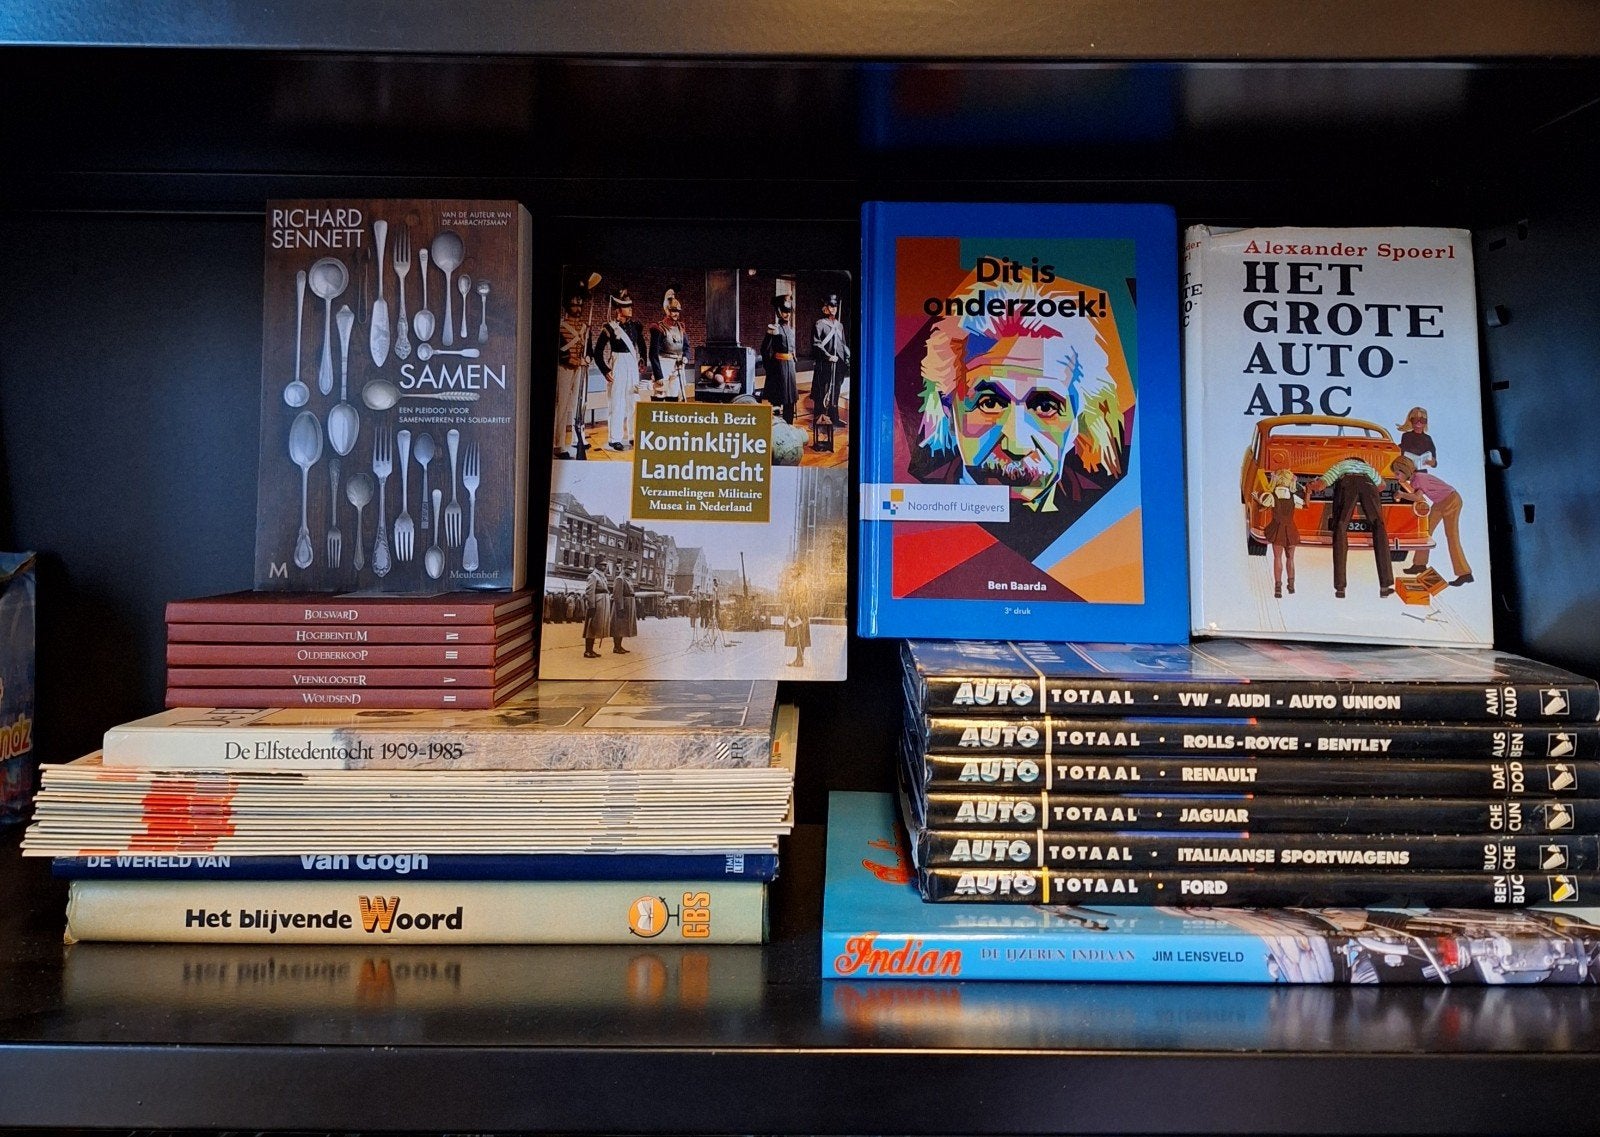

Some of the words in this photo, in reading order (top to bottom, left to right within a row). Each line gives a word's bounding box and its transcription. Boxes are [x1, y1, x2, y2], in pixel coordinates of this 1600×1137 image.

[273, 209, 362, 228] RICHARD
[442, 211, 456, 219] VAN
[458, 211, 467, 219] DE
[469, 211, 496, 219] AUTEUR
[497, 211, 512, 219] VAN
[272, 229, 364, 249] SENNETT
[1243, 240, 1367, 257] Alexander
[1377, 243, 1455, 261] Spoerl
[976, 256, 1022, 284] Dit
[1032, 256, 1055, 284] is
[1243, 261, 1363, 296] HET
[923, 290, 1107, 318] onderzoek!
[1243, 300, 1444, 338] GROTE
[1243, 342, 1408, 378] AUTO-
[399, 363, 506, 389] SAMEN
[399, 406, 413, 414] EEN
[415, 406, 447, 414] PLEIDOOI
[448, 406, 470, 414] VOOR
[1244, 383, 1352, 417] ABC
[399, 416, 453, 424] SAMENWERKEN
[456, 416, 466, 424] EN
[468, 416, 512, 424] SOLIDARITEIT
[651, 411, 719, 424] Historisch
[724, 412, 757, 425] Bezit
[639, 430, 767, 459] Koninklijke
[641, 459, 764, 482] Landmacht
[639, 486, 715, 500] Verzamelingen
[718, 488, 762, 499] Militaire
[649, 500, 682, 511] Musea
[685, 501, 696, 511] in
[700, 501, 753, 512] Nederland
[908, 501, 957, 512] Noordhoff
[960, 502, 1005, 514] Uitgevers
[269, 562, 288, 578] M
[450, 570, 499, 579] Meulenhoff
[988, 581, 1008, 590] Ben
[1010, 581, 1047, 591] Baarda
[952, 682, 1034, 706] AUTO
[1051, 689, 1134, 704] TOTAAL
[1178, 693, 1209, 707] VW
[1227, 693, 1271, 708] AUDI
[1289, 694, 1337, 709] AUTO
[1342, 695, 1401, 710] UNION
[1485, 688, 1498, 715] AMI
[1504, 686, 1517, 718] AUD
[224, 741, 250, 760] De
[254, 739, 374, 760] Elfstedentocht
[381, 742, 463, 760] 1909-1985
[958, 725, 1039, 748] AUTO
[1057, 731, 1140, 746] TOTAAL
[1183, 735, 1299, 750] ROLLS-ROYCE
[1317, 738, 1393, 752] BENTLEY
[1492, 732, 1506, 758] AUS
[1510, 733, 1524, 758] BEN
[958, 759, 1039, 783] AUTO
[1057, 765, 1141, 781] TOTAAL
[1182, 767, 1258, 782] RENAULT
[1491, 764, 1505, 790] DAF
[1510, 761, 1524, 793] DOD
[954, 801, 1036, 824] AUTO
[1053, 807, 1137, 822] TOTAAL
[1179, 809, 1249, 823] JAGUAR
[1489, 804, 1503, 830] CHE
[1508, 802, 1521, 832] CUN
[87, 856, 111, 868] DE
[116, 856, 192, 868] WERELD
[195, 856, 230, 868] VAN
[300, 854, 349, 870] Van
[356, 854, 429, 874] Gogh
[950, 839, 1031, 862] AUTO
[1049, 846, 1132, 861] TOTAAL
[1178, 848, 1275, 863] ITALIAANSE
[1280, 850, 1410, 865] SPORTWAGENS
[1483, 843, 1497, 871] BUG
[1502, 845, 1516, 870] CHE
[954, 872, 1036, 896] AUTO
[1053, 878, 1139, 893] TOTAAL
[1181, 880, 1228, 895] FORD
[1493, 875, 1506, 903] BEN
[1511, 874, 1525, 904] BUC
[185, 909, 231, 928] Het
[239, 909, 352, 934] blijvende
[358, 895, 463, 933] Woord
[682, 892, 710, 938] GBS
[834, 931, 963, 976] Indian
[1152, 951, 1173, 962] JIM
[1177, 951, 1245, 963] LENSVELD
